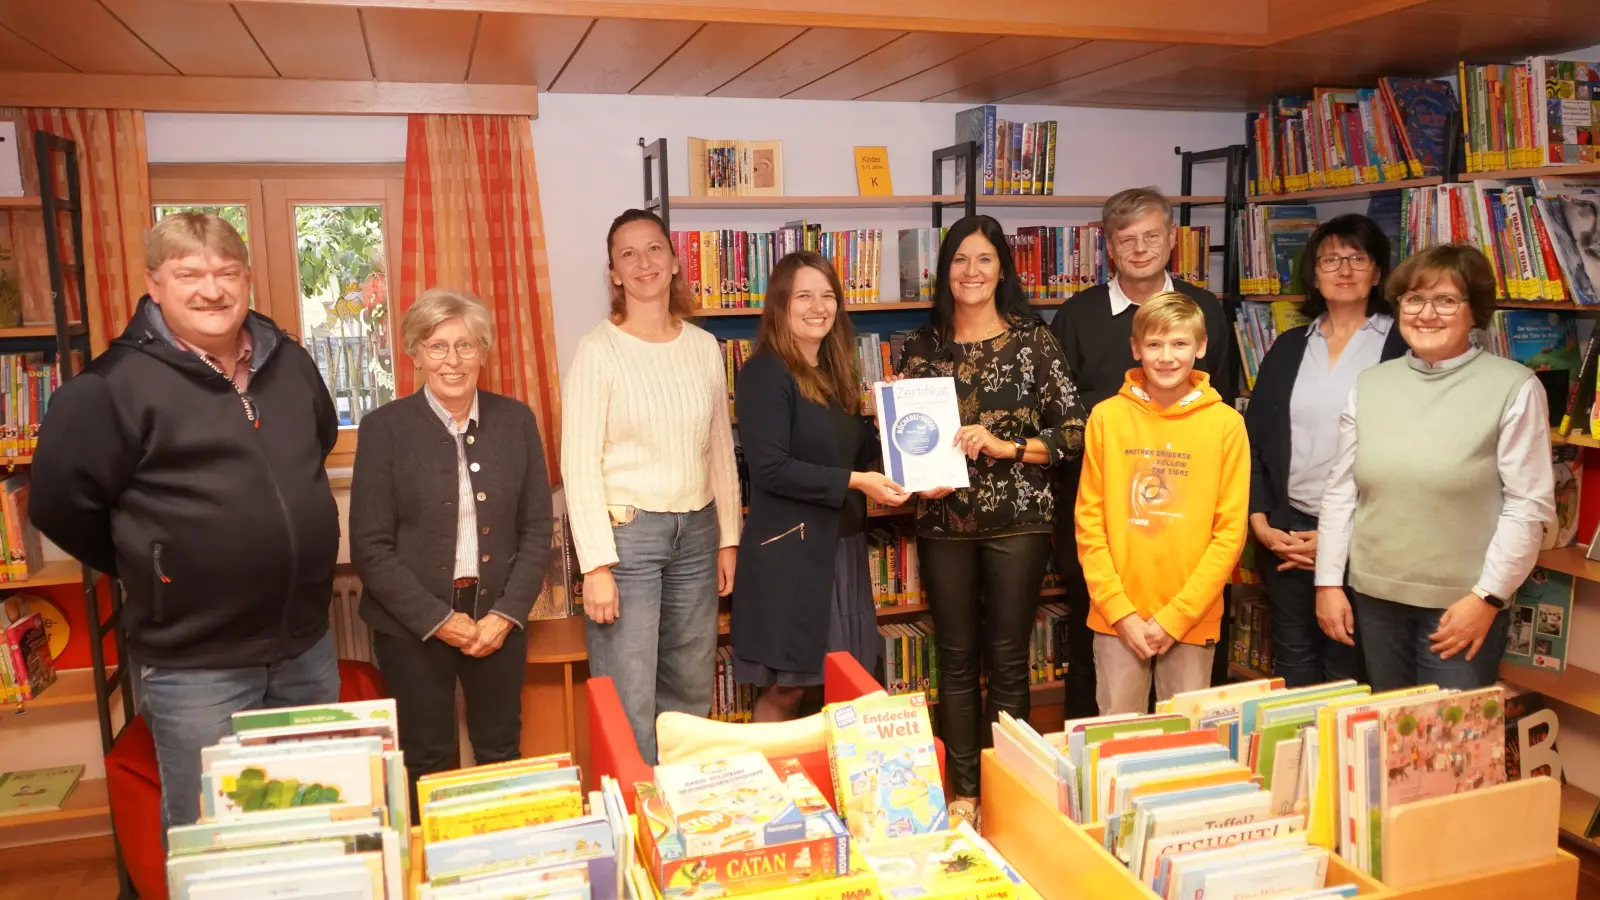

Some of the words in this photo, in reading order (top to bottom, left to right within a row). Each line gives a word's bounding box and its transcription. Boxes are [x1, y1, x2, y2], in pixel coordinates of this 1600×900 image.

[871, 177, 879, 187] K
[1511, 212, 1523, 247] TRAKTOR
[1519, 250, 1529, 273] TOTAL
[896, 385, 949, 399] Zertifikat
[1124, 448, 1154, 457] ANOTHER
[1156, 459, 1187, 468] FOLLOW
[1152, 467, 1165, 475] THE
[1167, 468, 1189, 477] SIGNS
[862, 709, 917, 724] Entdecke
[876, 721, 920, 739] Welt
[680, 811, 725, 834] STOP
[838, 836, 848, 875] KOSMOS
[726, 852, 787, 879] CATAN
